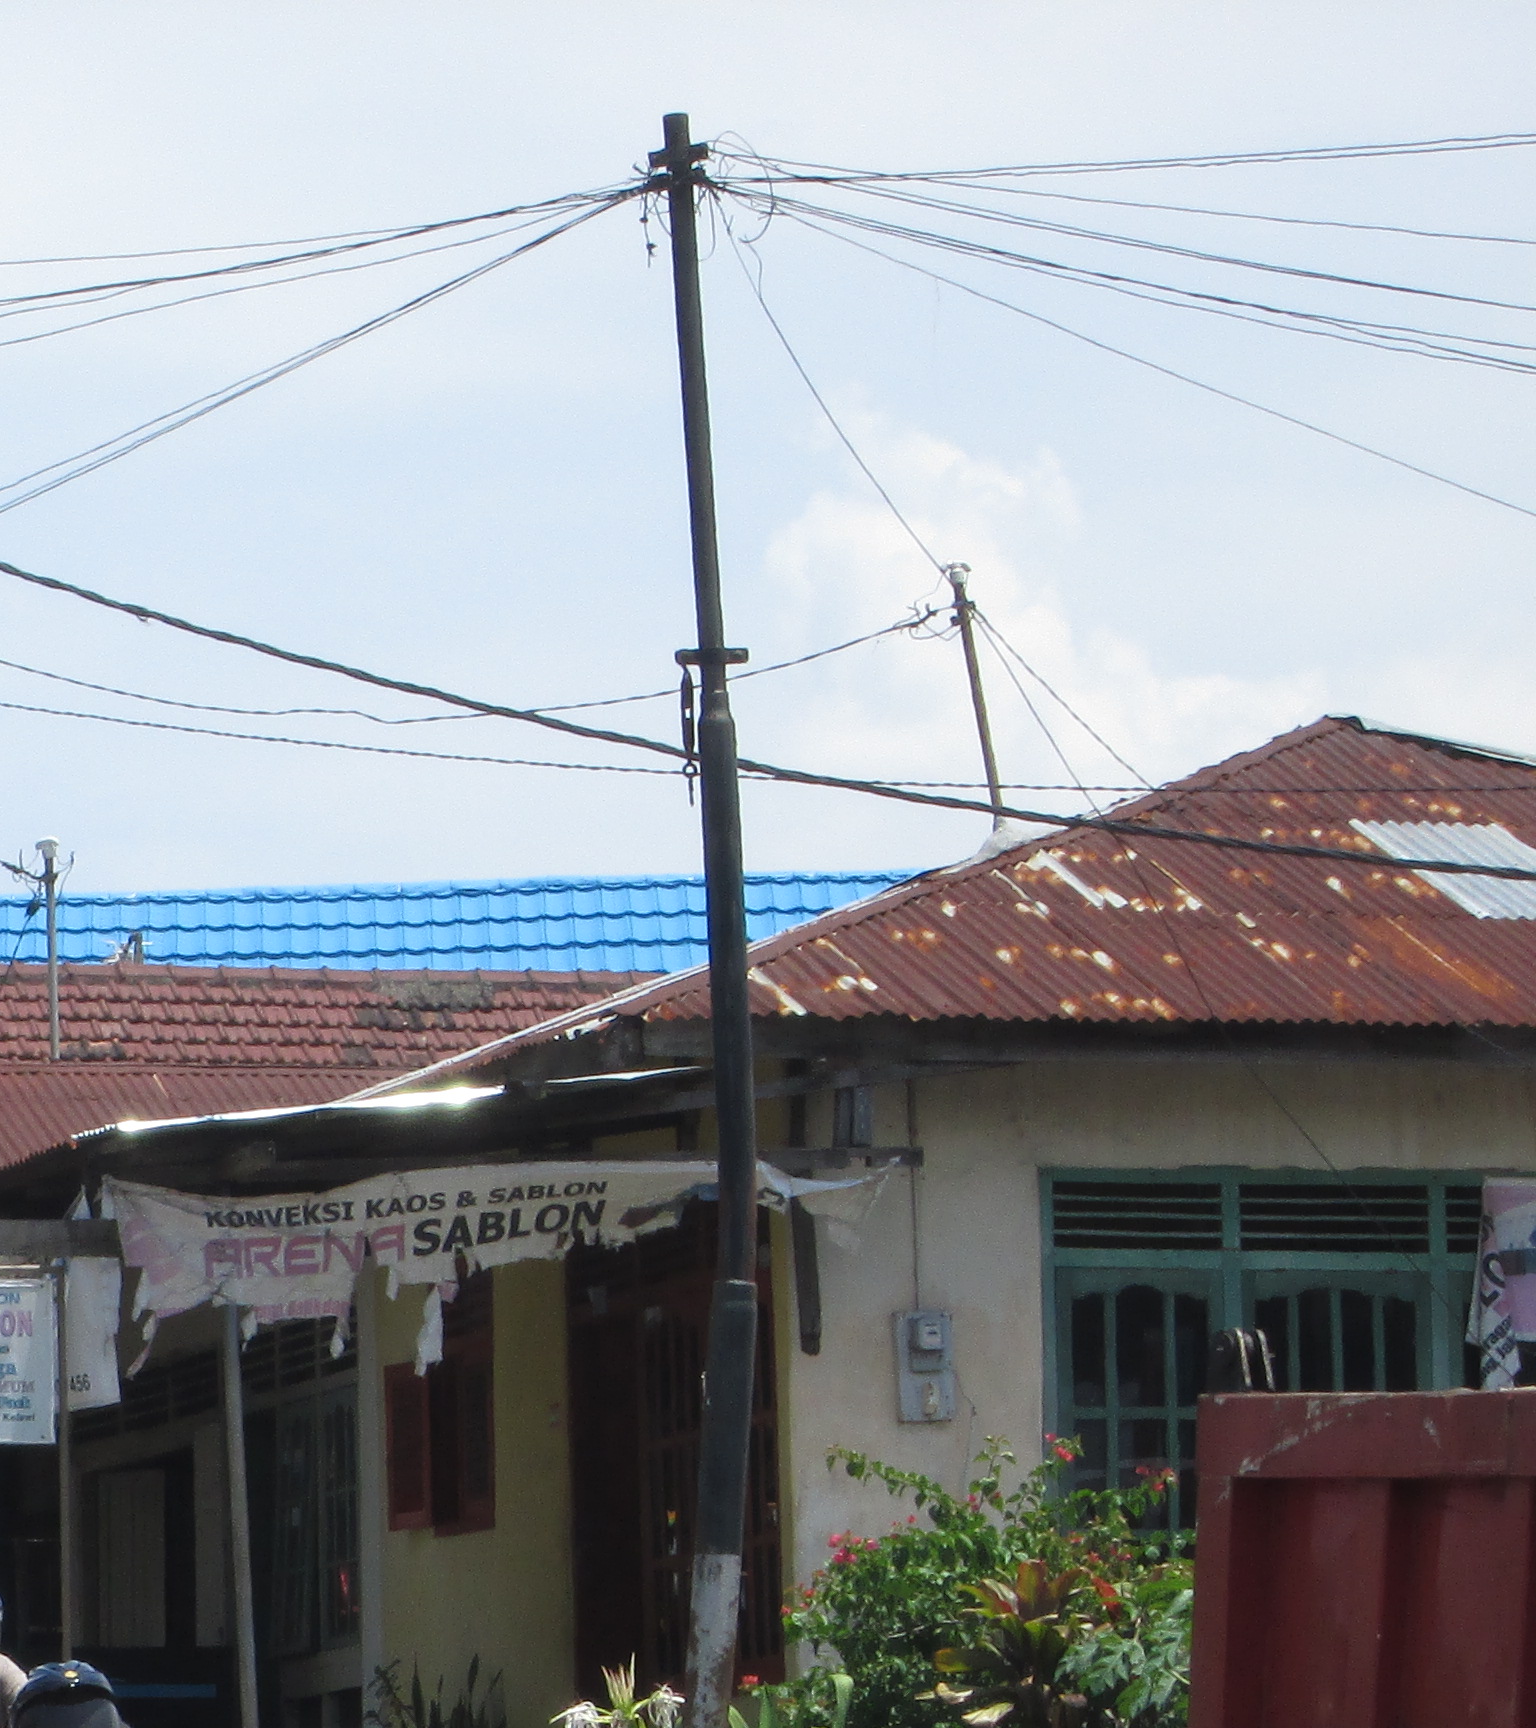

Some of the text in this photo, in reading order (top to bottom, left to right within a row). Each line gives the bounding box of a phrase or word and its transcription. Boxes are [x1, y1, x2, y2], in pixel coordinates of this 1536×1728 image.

[205, 1180, 609, 1230] KONVEKSI KAOS & SABLON
[203, 1199, 608, 1280] ARENA SABLON
